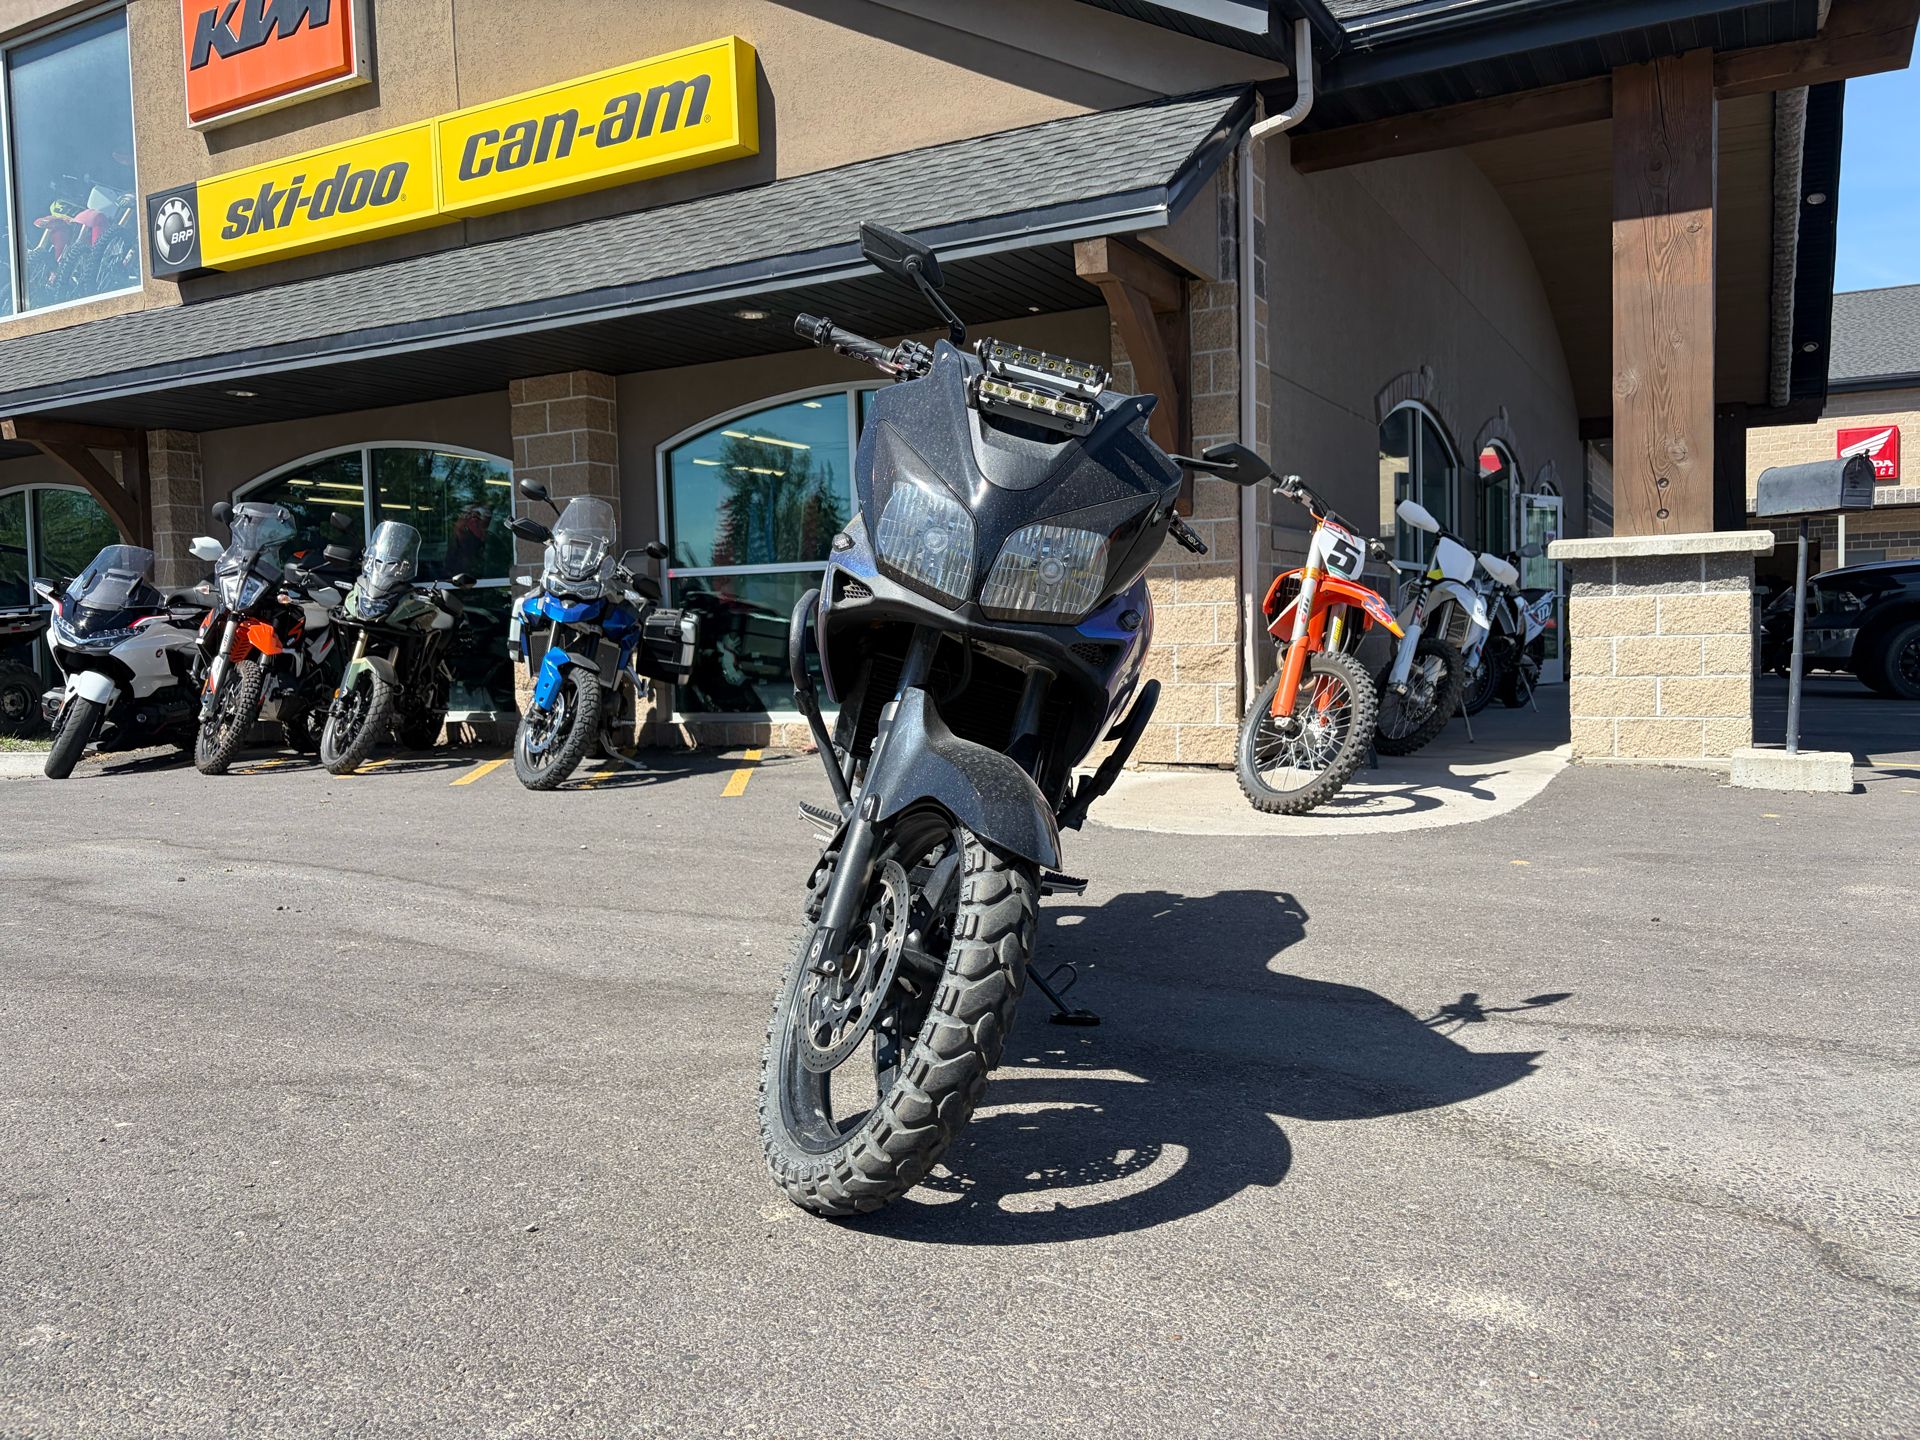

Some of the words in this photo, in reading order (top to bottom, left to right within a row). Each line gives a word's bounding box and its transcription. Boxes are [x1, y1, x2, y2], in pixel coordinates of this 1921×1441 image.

[458, 73, 712, 182] can-am
[221, 161, 410, 241] ski-doo
[171, 228, 194, 245] BRP
[1326, 538, 1361, 576] 5
